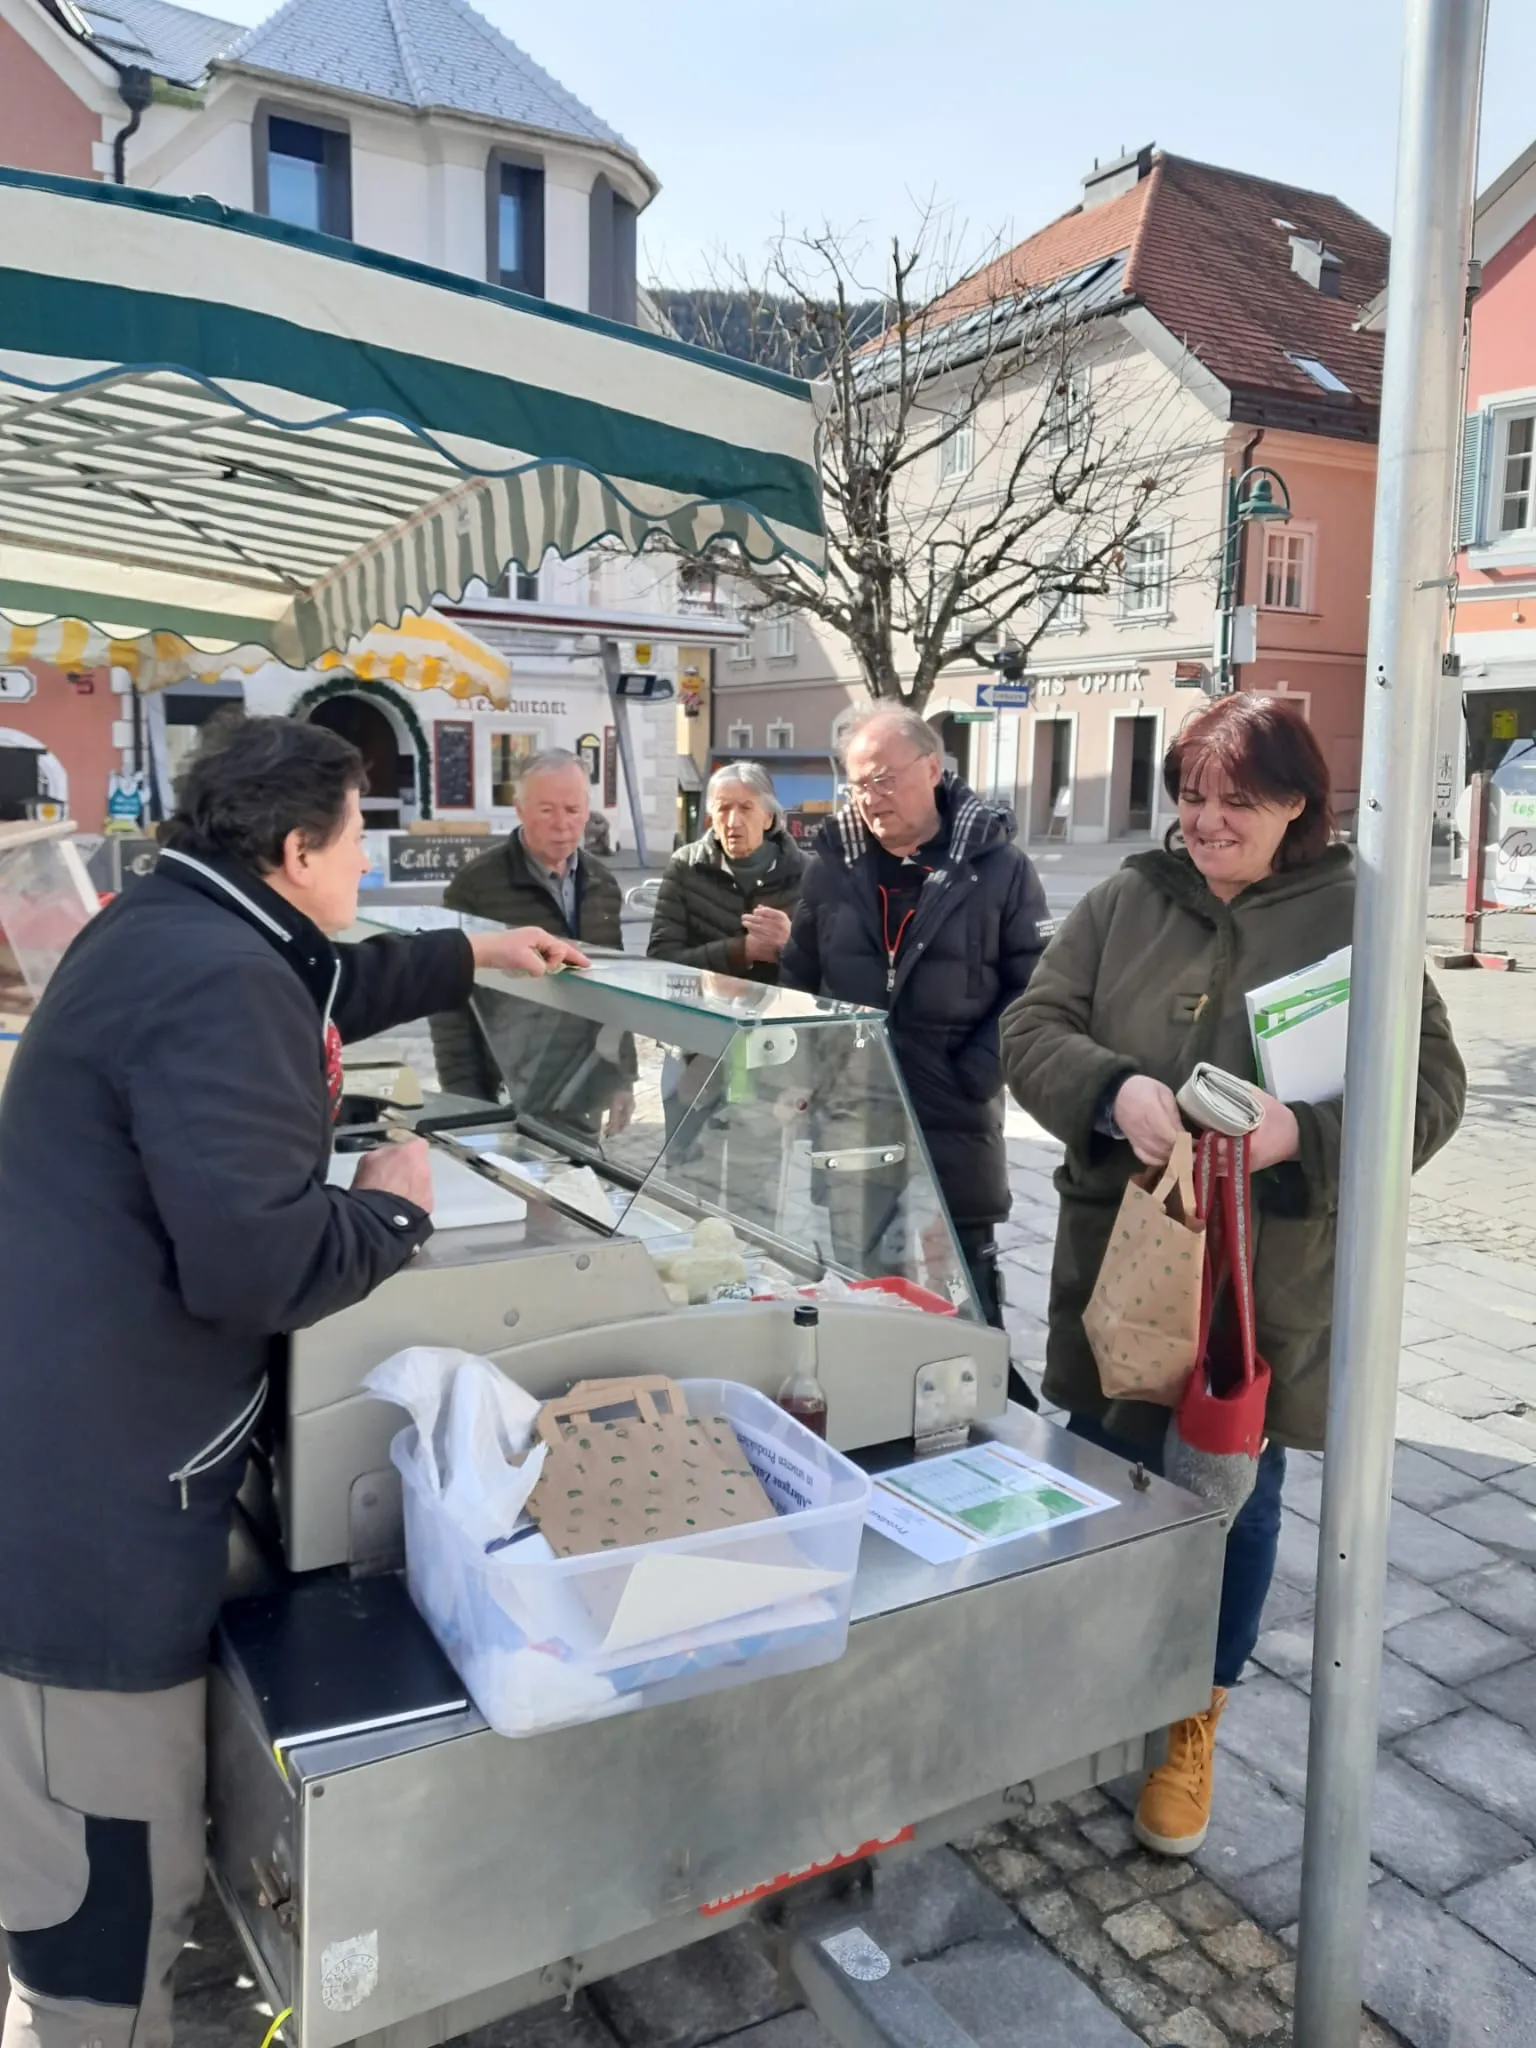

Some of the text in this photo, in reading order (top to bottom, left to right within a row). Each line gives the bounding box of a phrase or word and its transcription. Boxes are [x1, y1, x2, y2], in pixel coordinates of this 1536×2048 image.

[1030, 671, 1145, 697] HS OPTIK
[400, 847, 441, 869] Café
[446, 852, 460, 868] &
[1498, 830, 1536, 873] Ga
